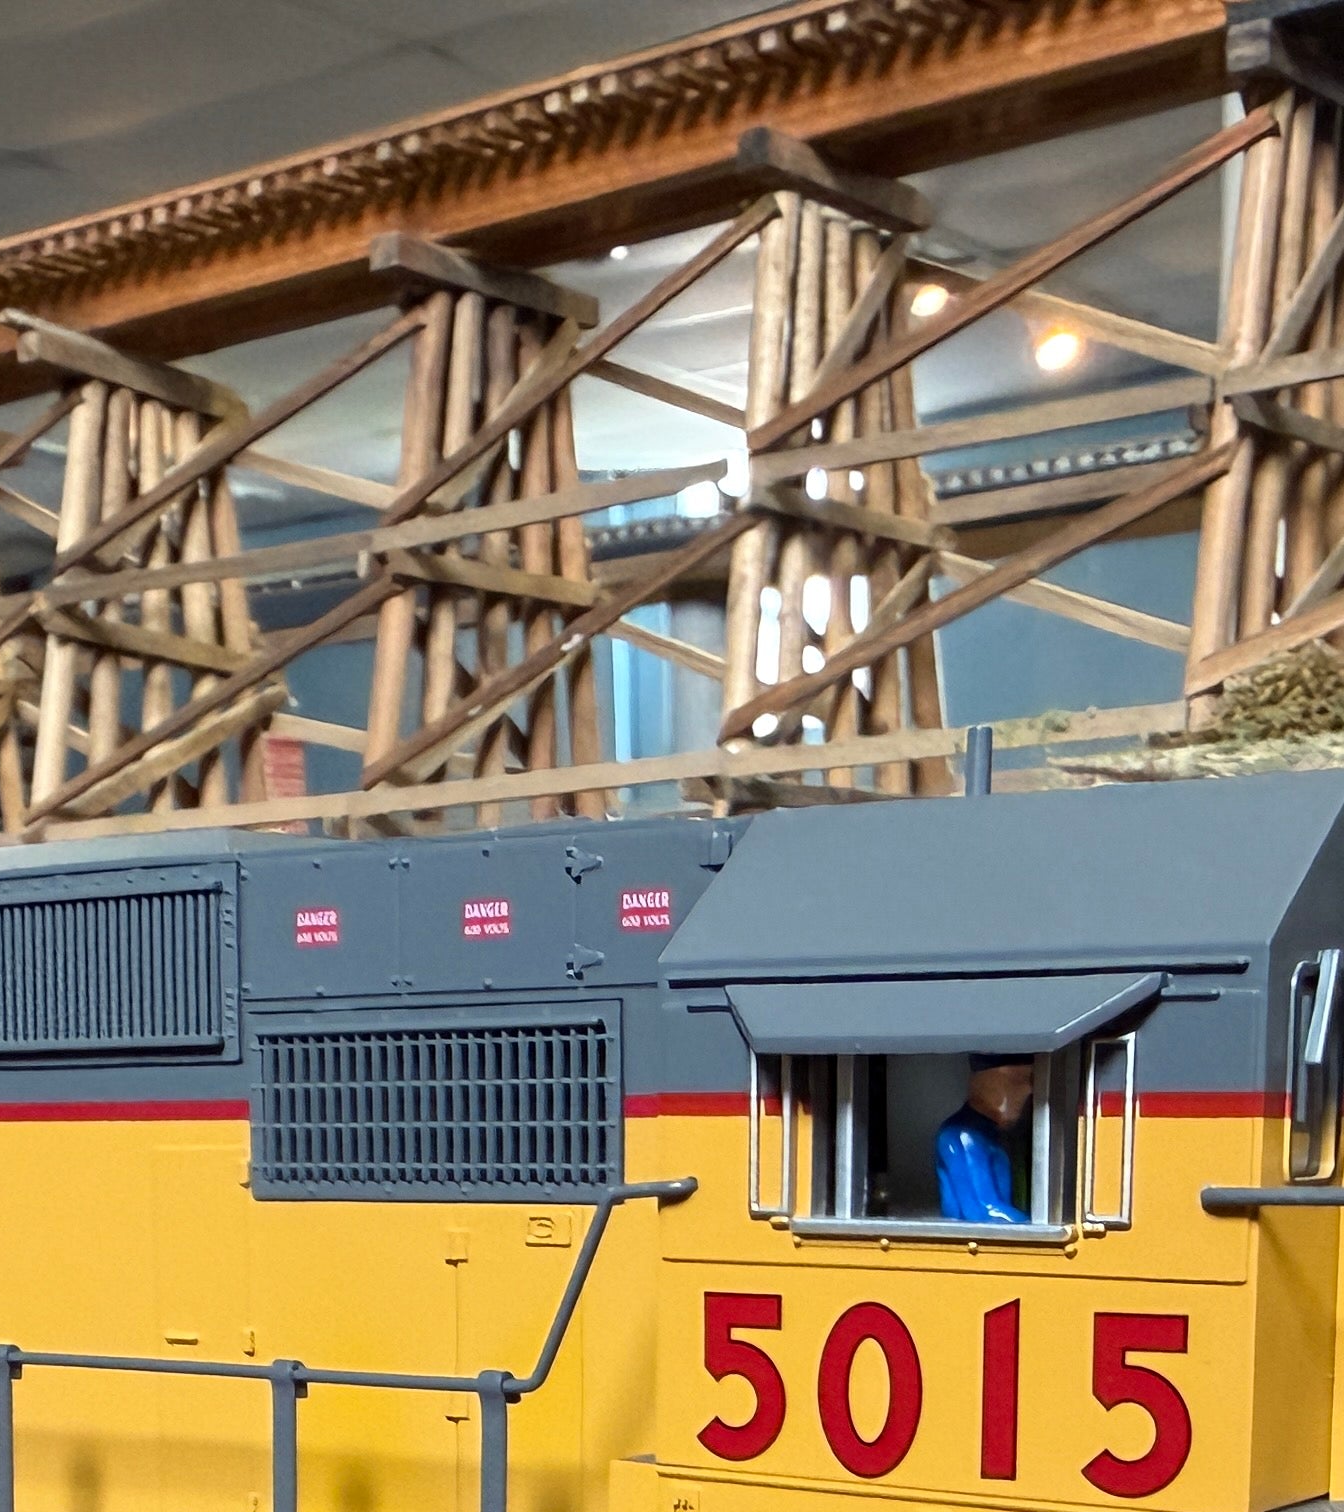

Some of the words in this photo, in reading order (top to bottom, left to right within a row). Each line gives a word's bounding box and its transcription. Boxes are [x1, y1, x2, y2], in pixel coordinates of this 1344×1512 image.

[621, 891, 670, 910] DANGER
[296, 910, 338, 927] DANGER
[464, 901, 509, 919] DANGER
[696, 1291, 1192, 1499] 5015
